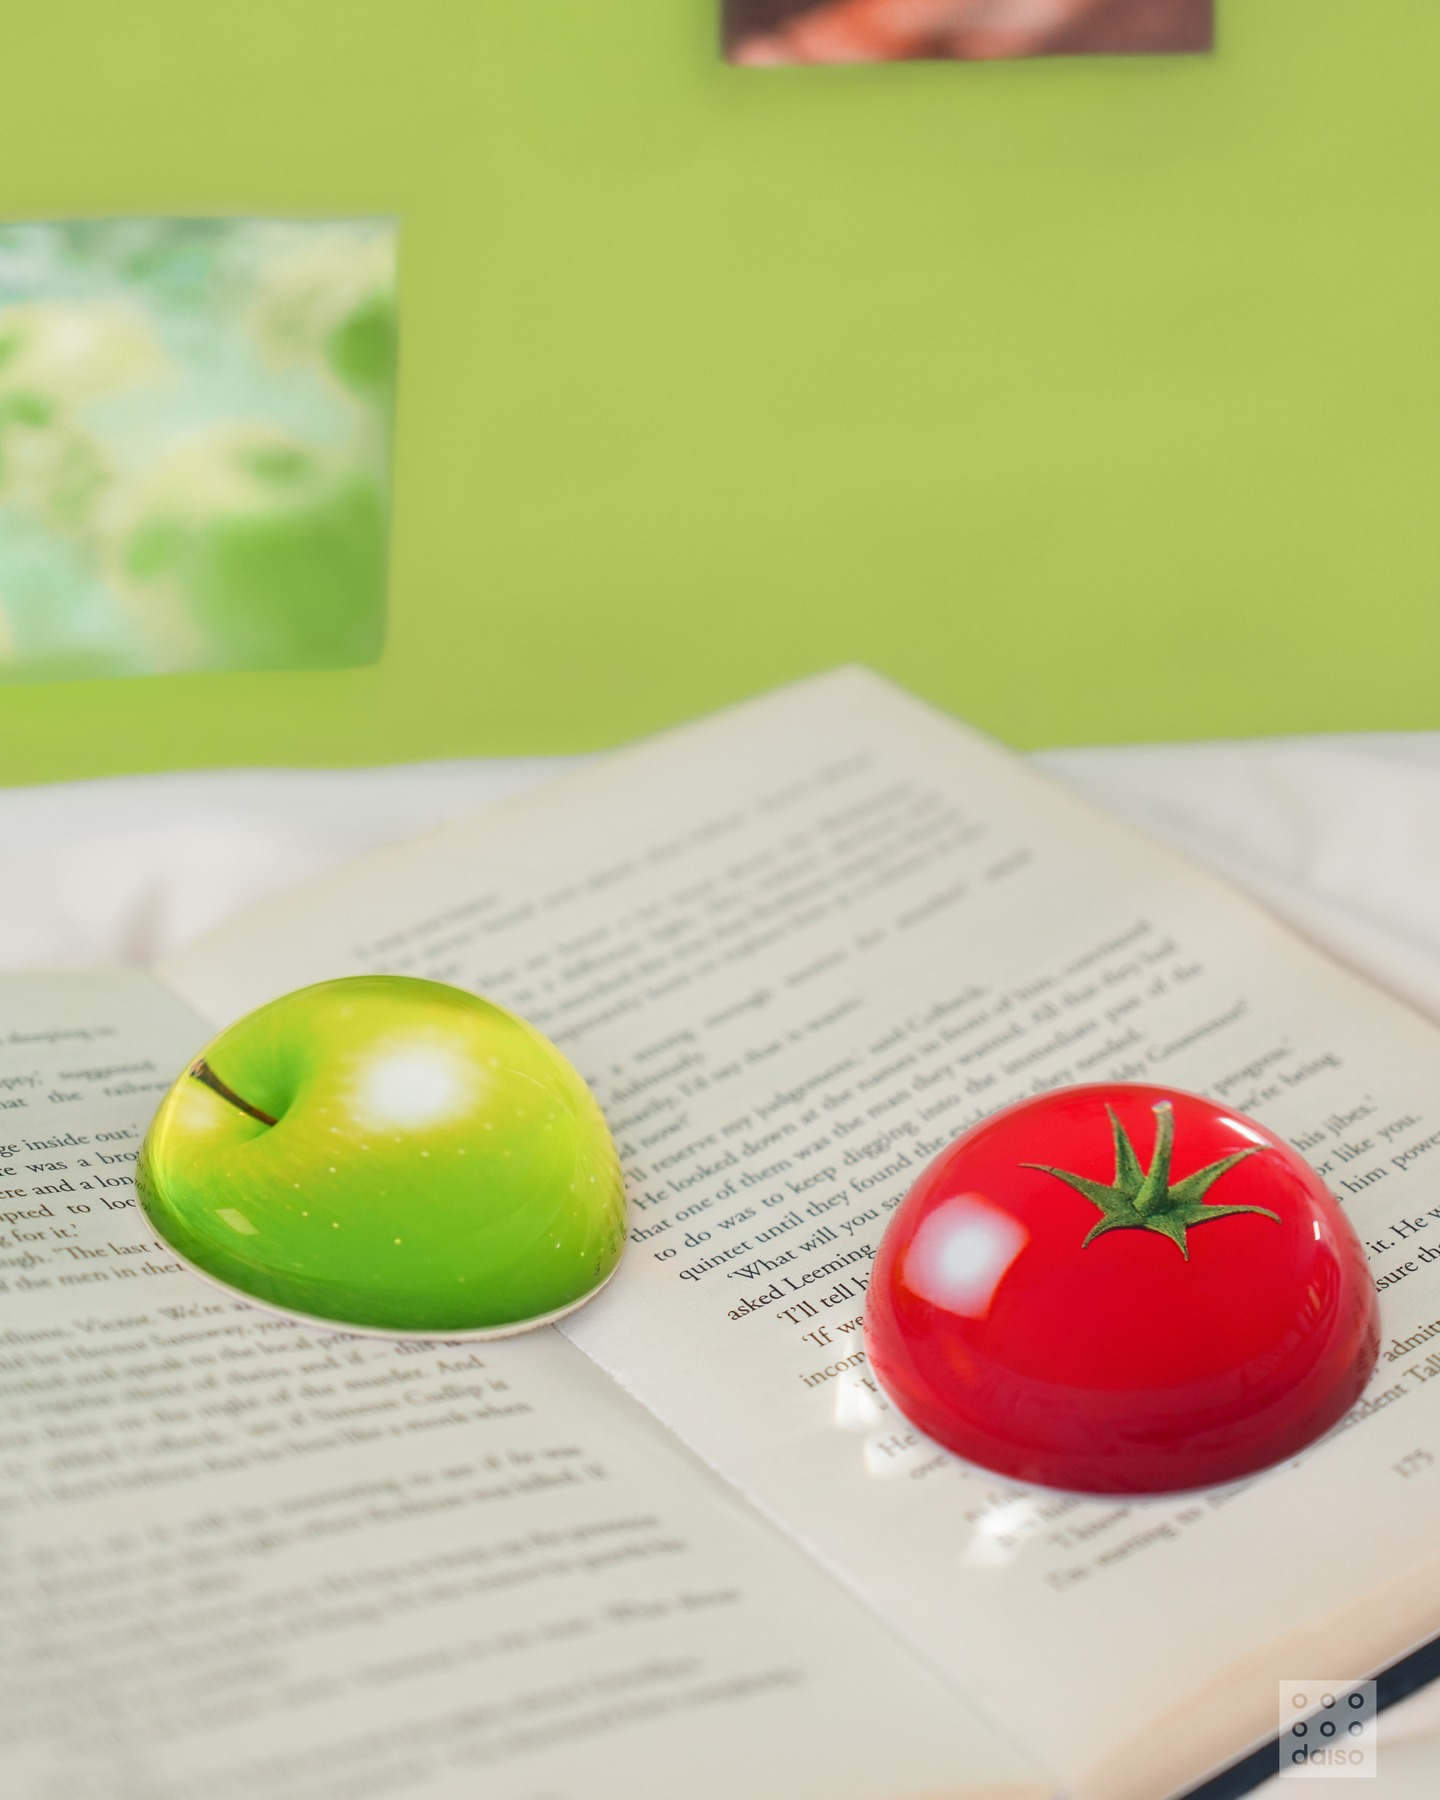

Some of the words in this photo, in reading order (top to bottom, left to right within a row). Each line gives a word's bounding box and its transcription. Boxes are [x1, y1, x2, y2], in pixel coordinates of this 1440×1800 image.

[1276, 1052, 1344, 1089] being
[48, 1088, 83, 1104] the
[629, 1218, 675, 1243] that
[675, 1195, 715, 1222] one
[714, 1179, 739, 1201] of
[738, 1157, 795, 1189] them
[793, 1136, 833, 1161] was
[831, 1115, 867, 1140] the
[865, 1089, 912, 1119] man
[910, 1062, 956, 1093] they
[955, 1017, 1030, 1067] wanted.
[631, 1190, 669, 1211] He
[666, 1150, 741, 1194] looked
[741, 1121, 799, 1158] down
[800, 1108, 822, 1126] at
[821, 1086, 856, 1112] the
[856, 1054, 918, 1092] names
[919, 1039, 942, 1058] in
[1289, 1129, 1327, 1152] his
[1330, 1138, 1375, 1163] like
[1377, 1115, 1423, 1144] you.
[22, 1132, 91, 1151] inside
[650, 1132, 718, 1174] reserve
[720, 1115, 753, 1140] my
[25, 1161, 68, 1174] was
[77, 1157, 92, 1168] a
[95, 1151, 140, 1165] bro
[653, 1247, 678, 1263] to
[684, 1230, 712, 1248] do
[716, 1206, 758, 1230] was
[761, 1192, 785, 1208] to
[784, 1165, 837, 1196] keep
[841, 1119, 921, 1167] digging
[916, 1093, 963, 1122] into
[964, 1072, 998, 1096] the
[32, 1178, 75, 1196] and
[80, 1181, 95, 1190] a
[1339, 1167, 1389, 1194] him
[0, 1203, 56, 1225] pted
[66, 1203, 91, 1215] to
[679, 1239, 755, 1290] quintet
[754, 1210, 806, 1244] until
[805, 1189, 852, 1219] they
[849, 1153, 915, 1194] found
[913, 1135, 949, 1159] the
[10, 1228, 46, 1243] for
[726, 1249, 799, 1281] 'What
[799, 1225, 840, 1253] will
[839, 1207, 880, 1237] you
[1388, 1218, 1429, 1240] He
[107, 1242, 150, 1256] last
[110, 1266, 137, 1279] in
[1375, 1261, 1419, 1293] sure
[727, 1284, 787, 1322] asked
[819, 1282, 857, 1309] tell
[850, 1271, 870, 1291] h
[801, 1325, 835, 1348] 'If
[836, 1315, 864, 1334] we
